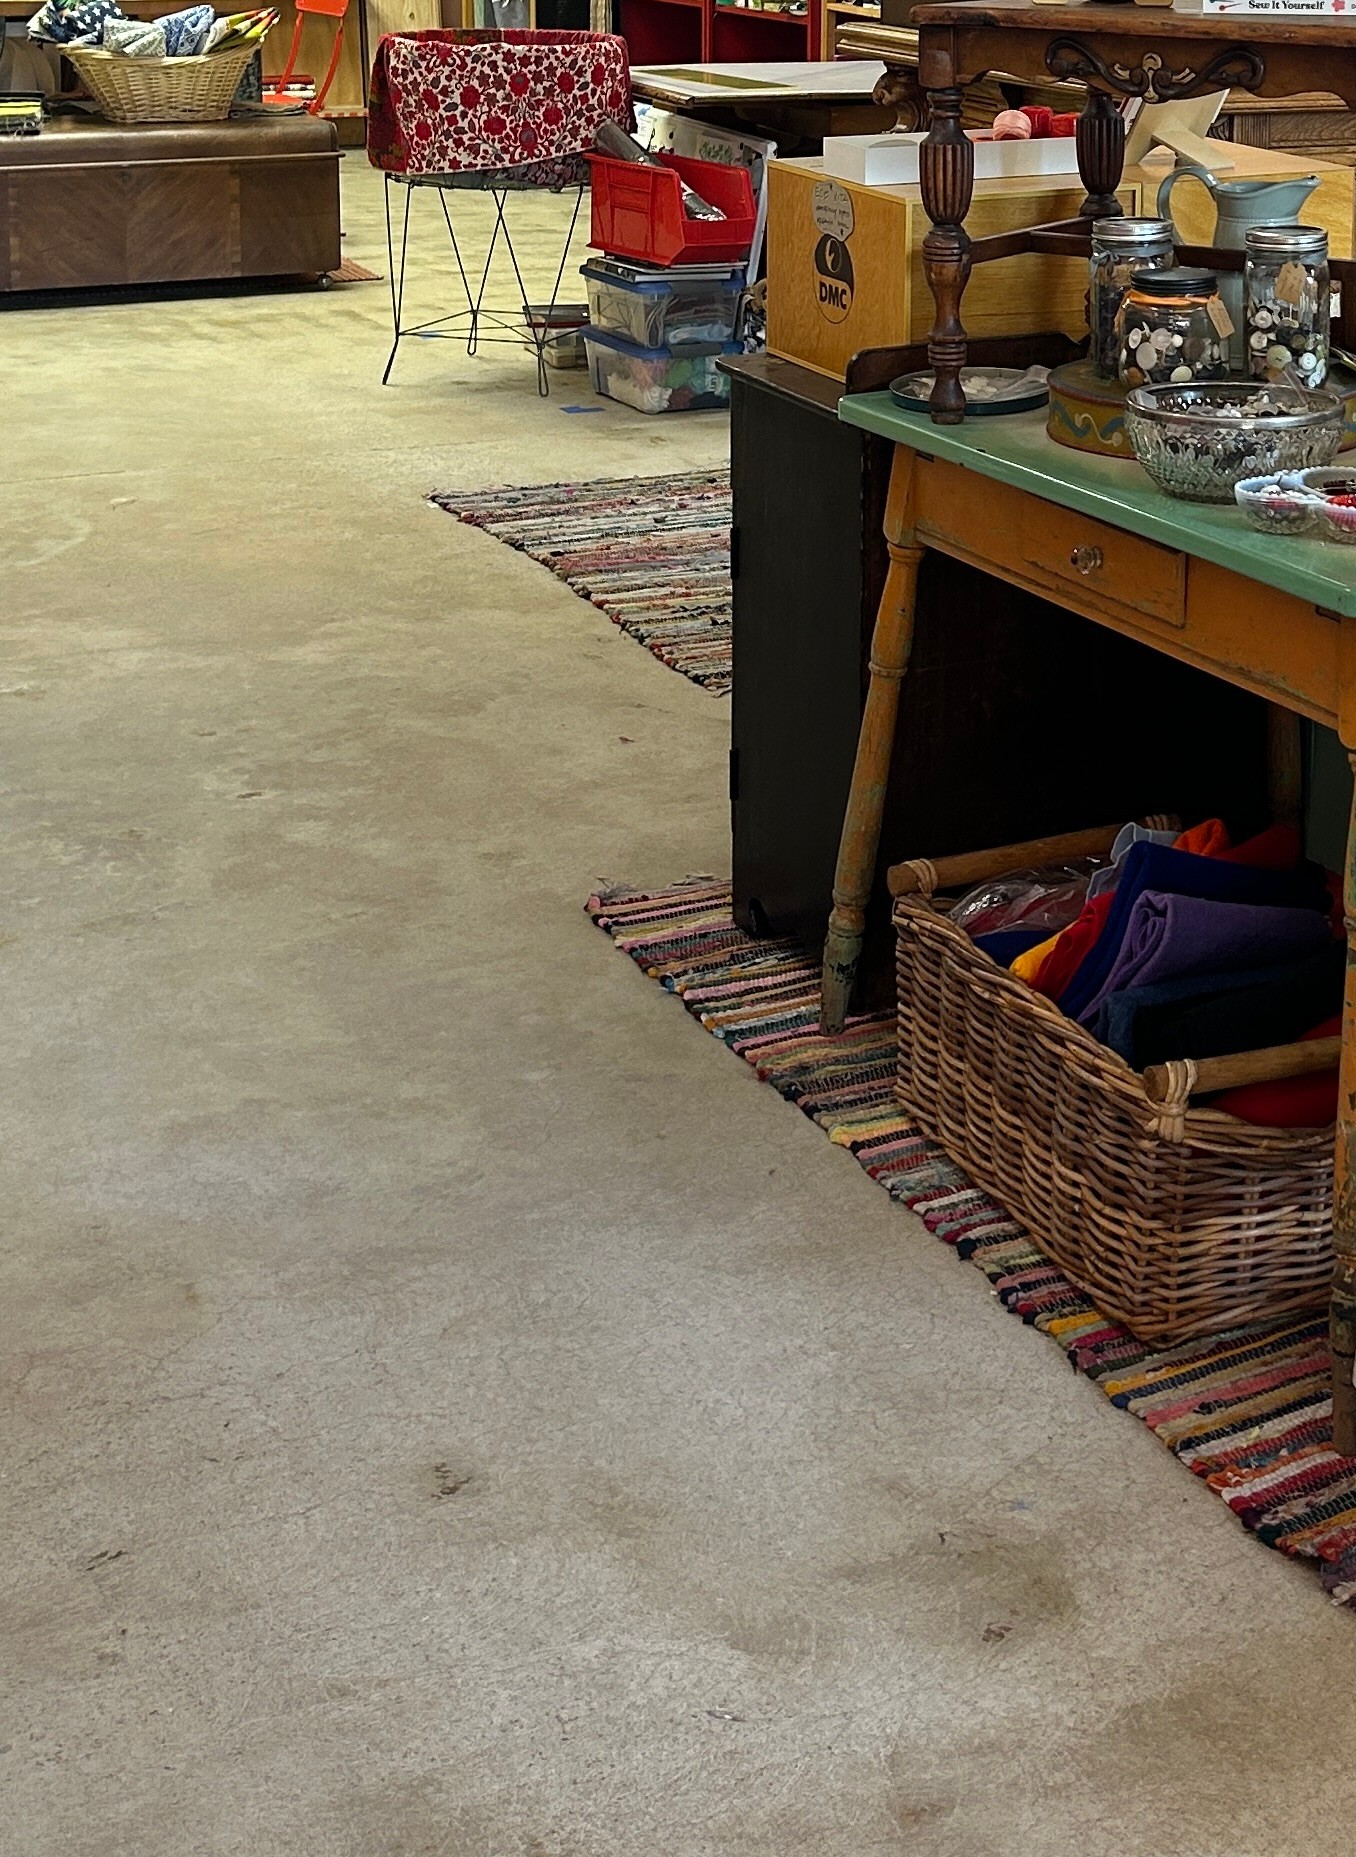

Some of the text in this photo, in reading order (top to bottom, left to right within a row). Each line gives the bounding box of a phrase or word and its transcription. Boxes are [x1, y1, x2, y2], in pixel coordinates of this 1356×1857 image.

[1248, 0, 1270, 9] Sew
[1272, 1, 1280, 9] It
[1282, 1, 1325, 10] Yourself
[819, 281, 847, 310] DMC
